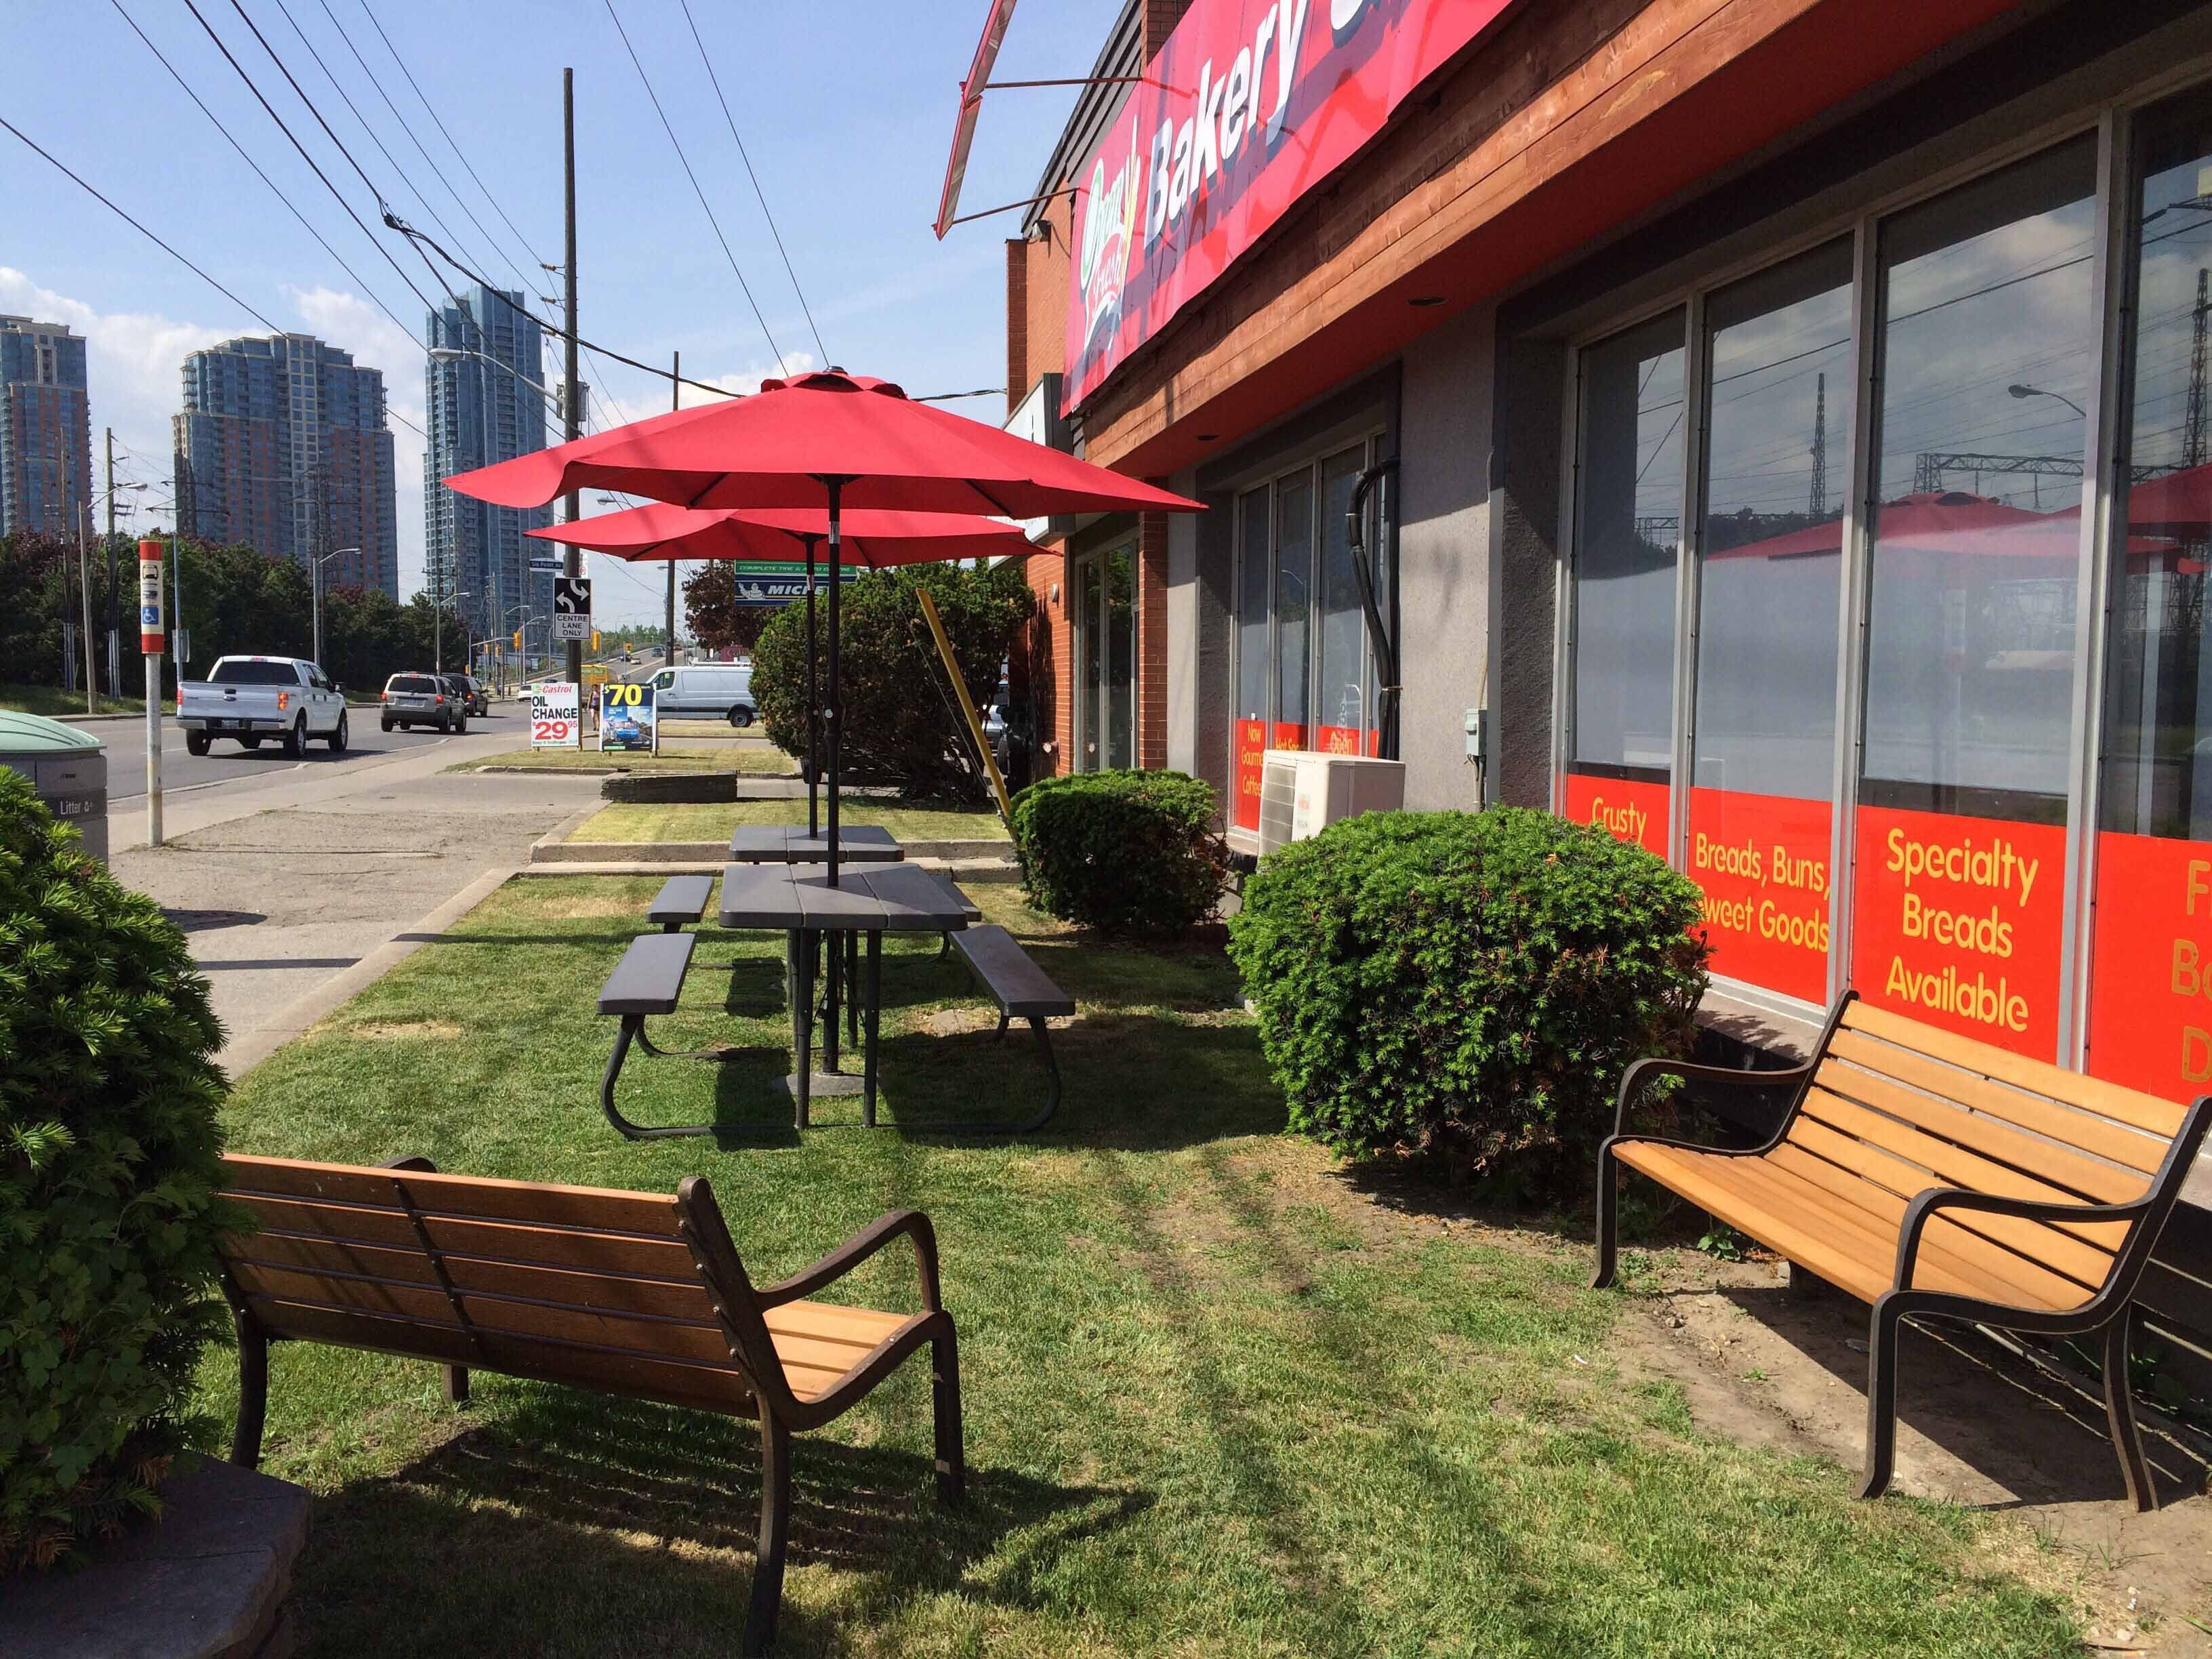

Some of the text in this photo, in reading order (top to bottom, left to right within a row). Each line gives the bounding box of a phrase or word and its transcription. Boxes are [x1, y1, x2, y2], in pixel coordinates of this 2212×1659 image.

[1144, 0, 1307, 249] Bakery
[532, 695, 548, 707] OIL
[532, 708, 577, 719] CHANGE
[543, 685, 572, 693] Castrol
[604, 684, 642, 705] $70
[1248, 722, 1261, 743] Now
[60, 800, 81, 815] Litter
[1591, 796, 1647, 844] Crusty
[1696, 832, 1831, 900] Breads, Buns,
[1886, 827, 2039, 907] Specialty
[2186, 859, 2212, 916] F
[1759, 899, 1830, 953] Goods
[1902, 892, 2013, 958] Breads
[1885, 954, 2029, 1033] Available
